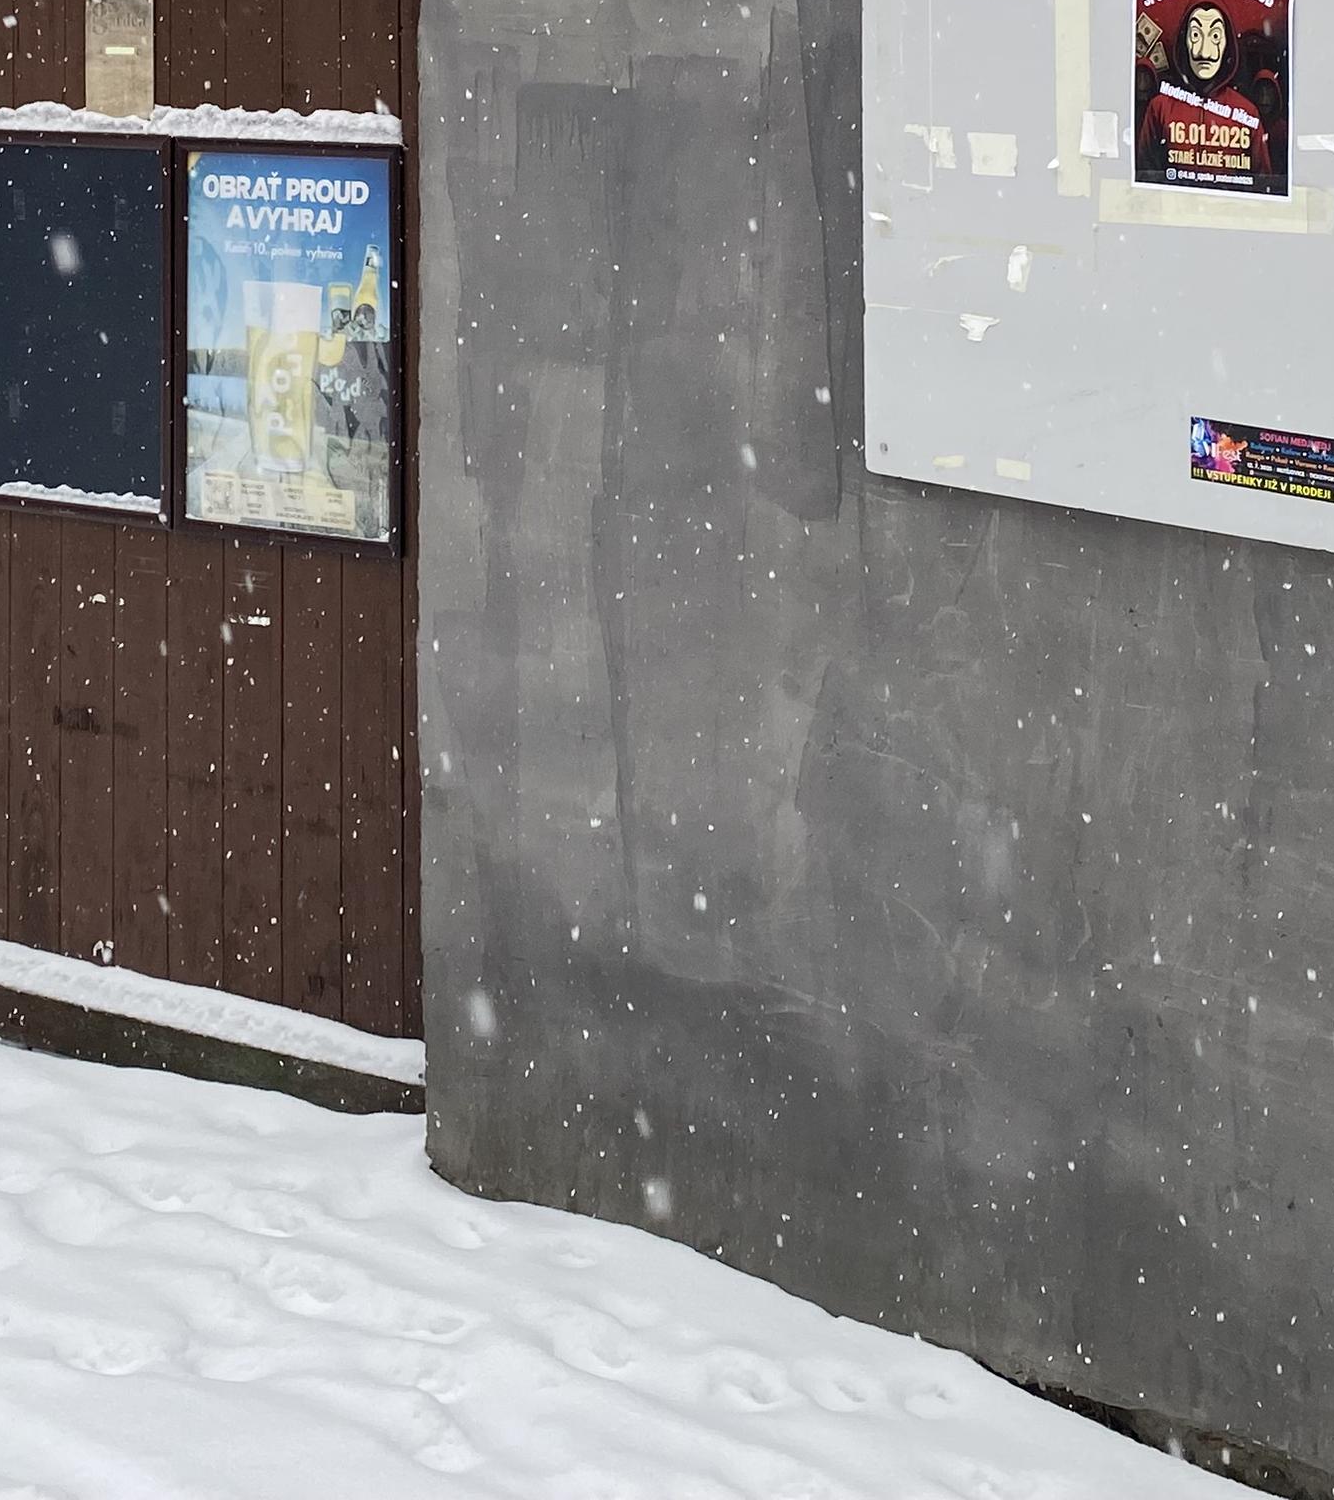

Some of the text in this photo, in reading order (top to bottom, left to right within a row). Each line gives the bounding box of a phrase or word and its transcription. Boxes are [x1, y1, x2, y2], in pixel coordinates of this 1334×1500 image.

[1168, 121, 1251, 149] 16.01.2026
[1168, 148, 1195, 165] STARÉ
[1196, 149, 1223, 167] LÁZNĚ
[202, 171, 370, 205] OBRAŤ PROUD
[226, 204, 344, 235] A VYHRAJ
[1205, 468, 1263, 487] VSTUPENKY
[1264, 479, 1278, 491] JIŽ
[1280, 482, 1288, 492] V
